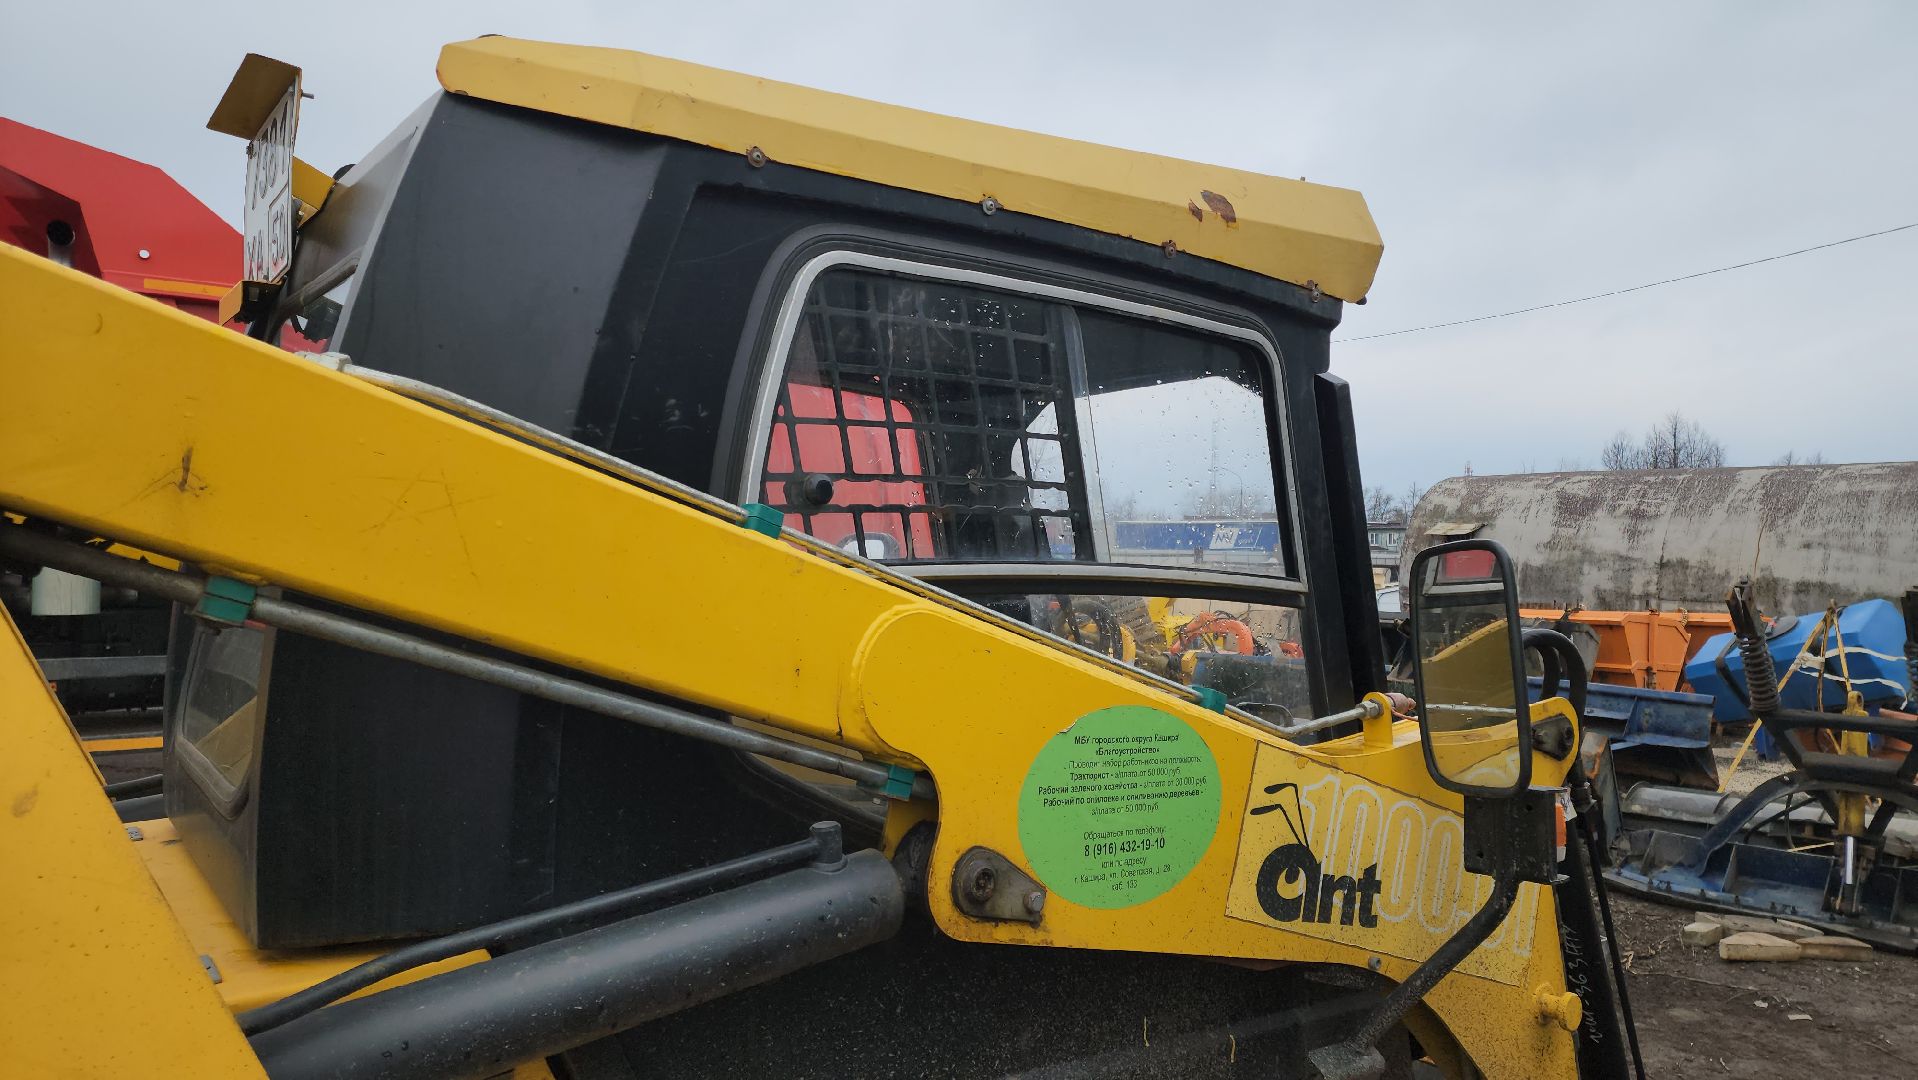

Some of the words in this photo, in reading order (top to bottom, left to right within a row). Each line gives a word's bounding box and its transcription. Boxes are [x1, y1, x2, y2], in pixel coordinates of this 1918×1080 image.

[272, 204, 287, 267] 50
[1074, 735, 1091, 745] МБУ
[1092, 736, 1130, 745] городского
[1131, 735, 1153, 745] округа
[1154, 733, 1180, 743] Кашира
[1095, 747, 1160, 757] «Благоустройство»
[1101, 758, 1121, 769] набор
[1122, 758, 1159, 768] работников
[1069, 772, 1110, 782] Тракторист
[1038, 785, 1069, 796] Рабочий
[1070, 784, 1102, 793] зеленого
[1103, 781, 1138, 792] хозяйства
[1043, 797, 1075, 808] Рабочий
[1075, 797, 1085, 805] по
[1168, 788, 1200, 799] деревьев
[1116, 806, 1124, 814] от
[1125, 803, 1134, 813] 50
[1134, 803, 1147, 812] 000
[1083, 831, 1123, 841] Обращаться
[1084, 844, 1090, 857] 8
[1093, 841, 1117, 860] (916)
[1119, 837, 1165, 854] 432-19-10
[1101, 860, 1114, 869] или
[1114, 859, 1123, 868] по
